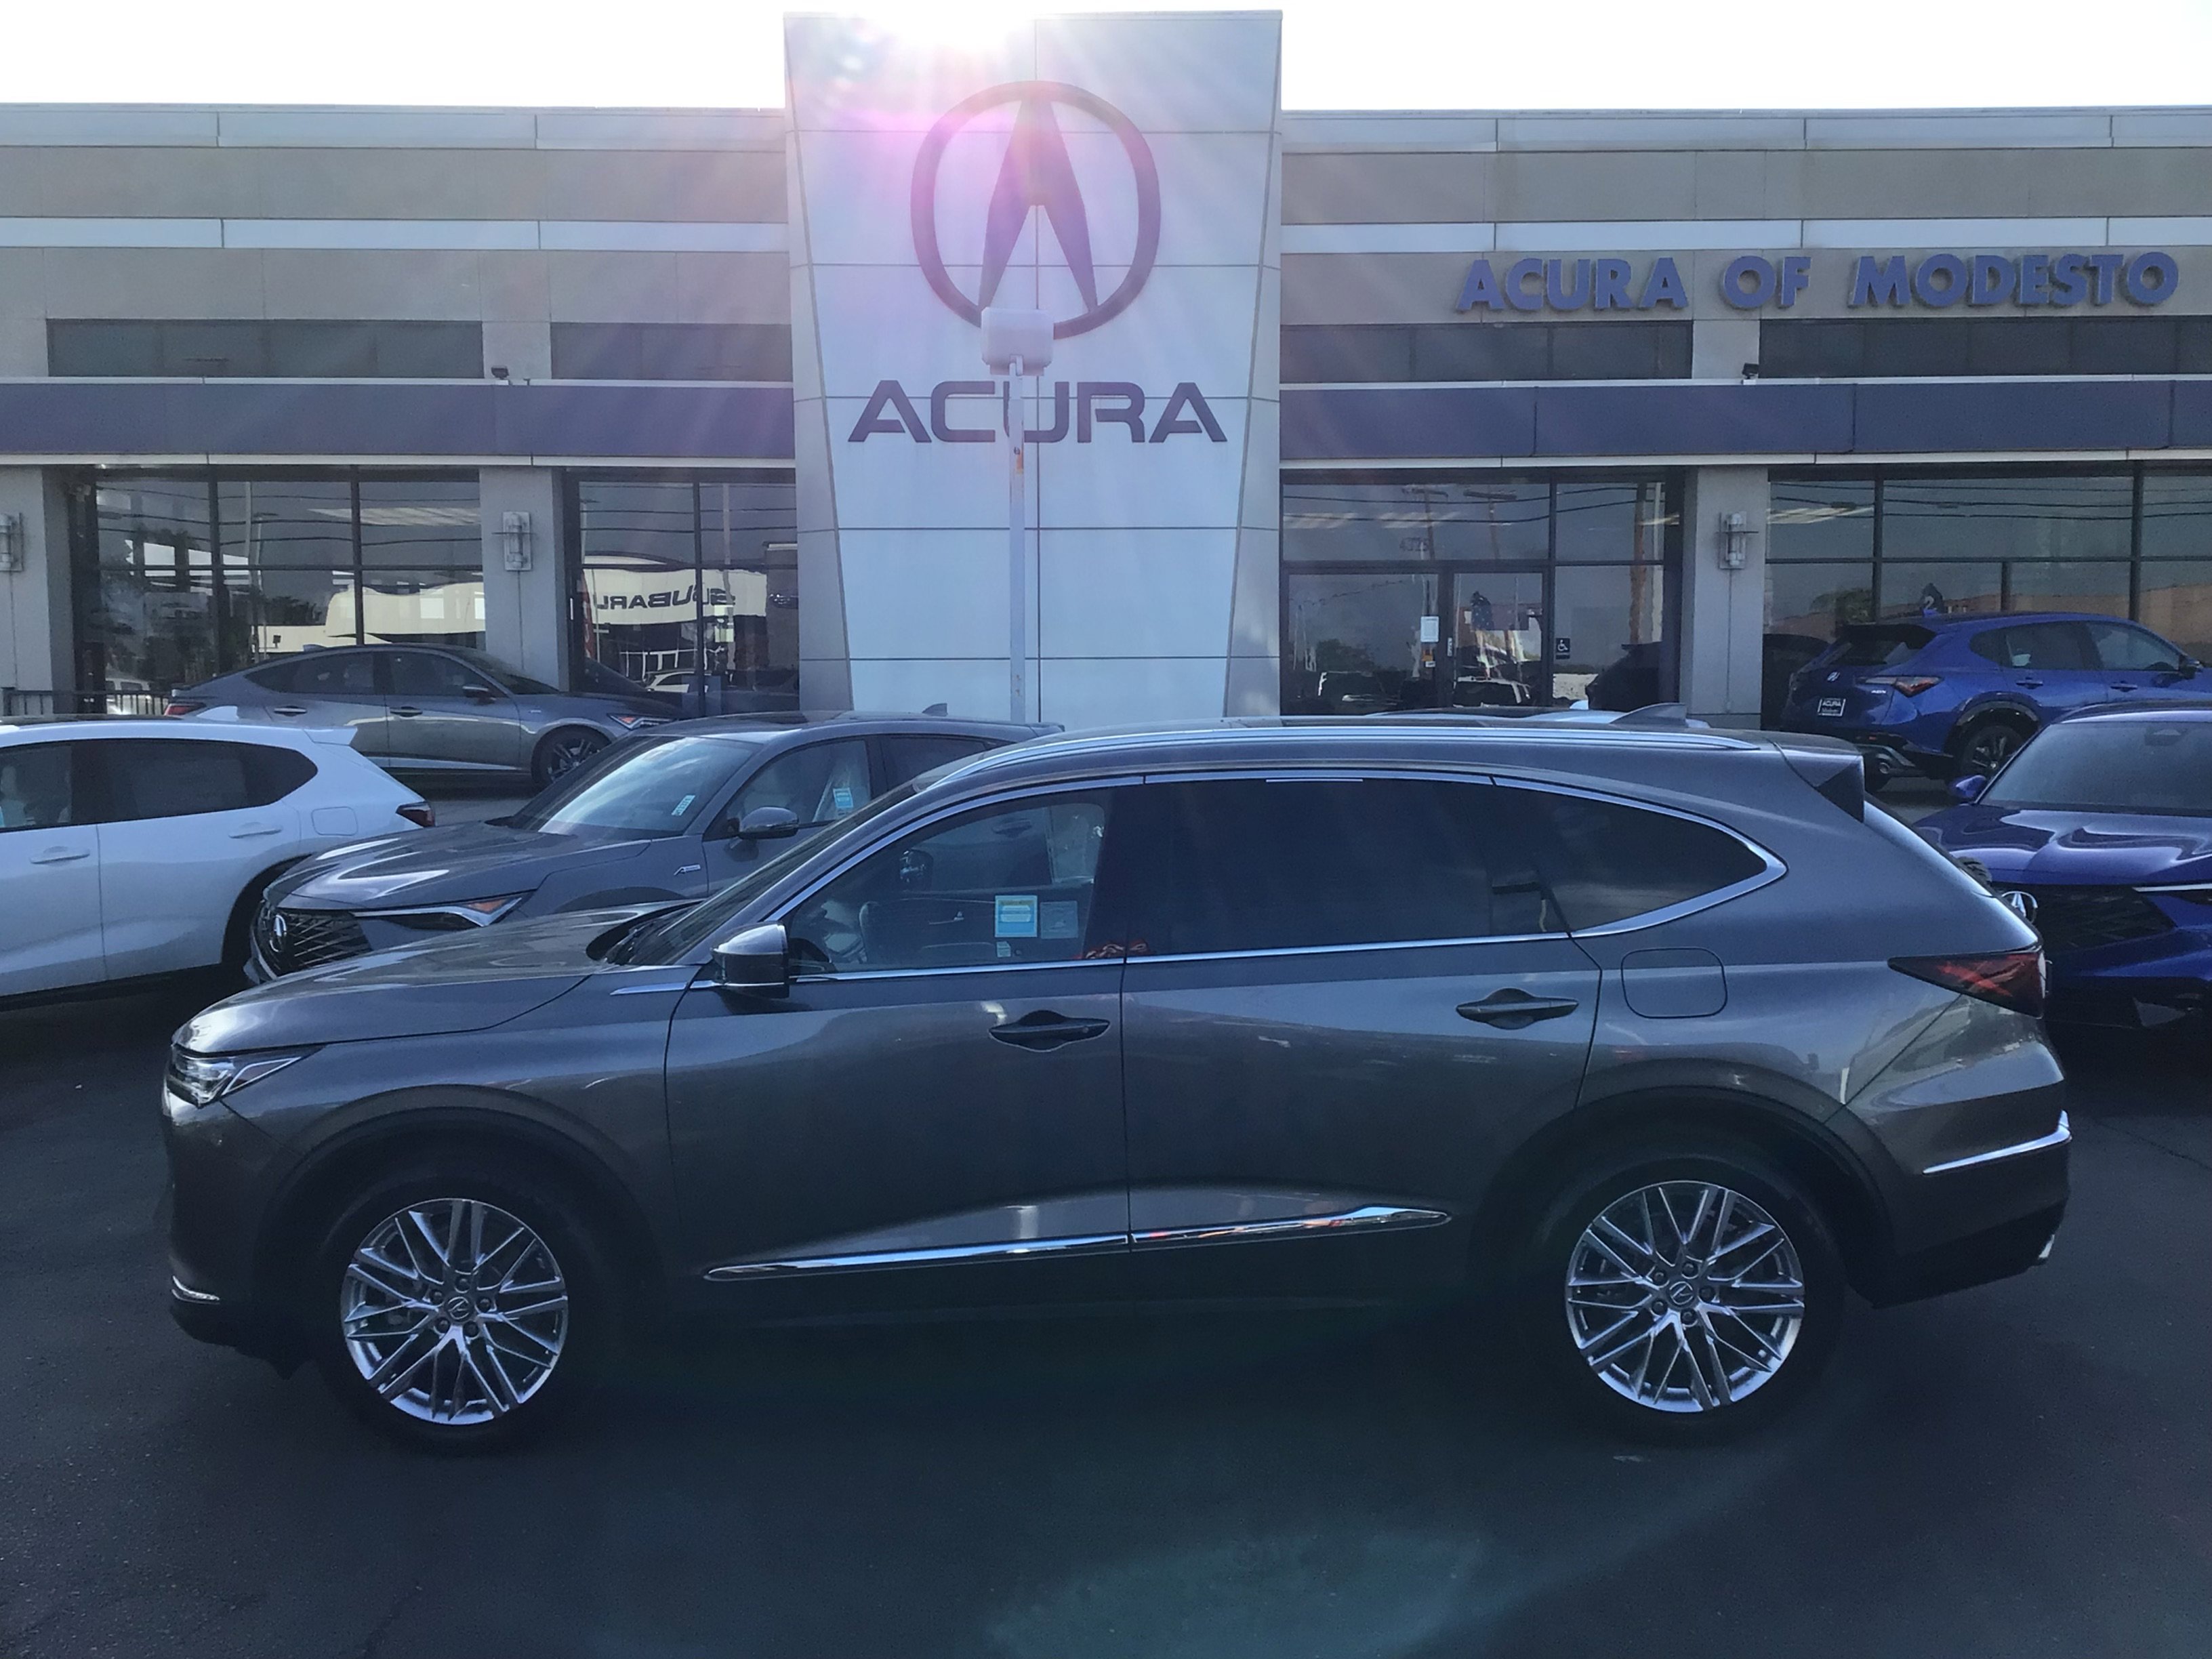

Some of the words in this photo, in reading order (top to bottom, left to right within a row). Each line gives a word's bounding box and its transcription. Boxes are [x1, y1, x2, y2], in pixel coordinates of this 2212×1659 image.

[1456, 257, 1688, 311] ACURA
[1723, 255, 1811, 309] OF
[1850, 251, 2179, 308] MODESTO
[848, 380, 1227, 444] ACURA
